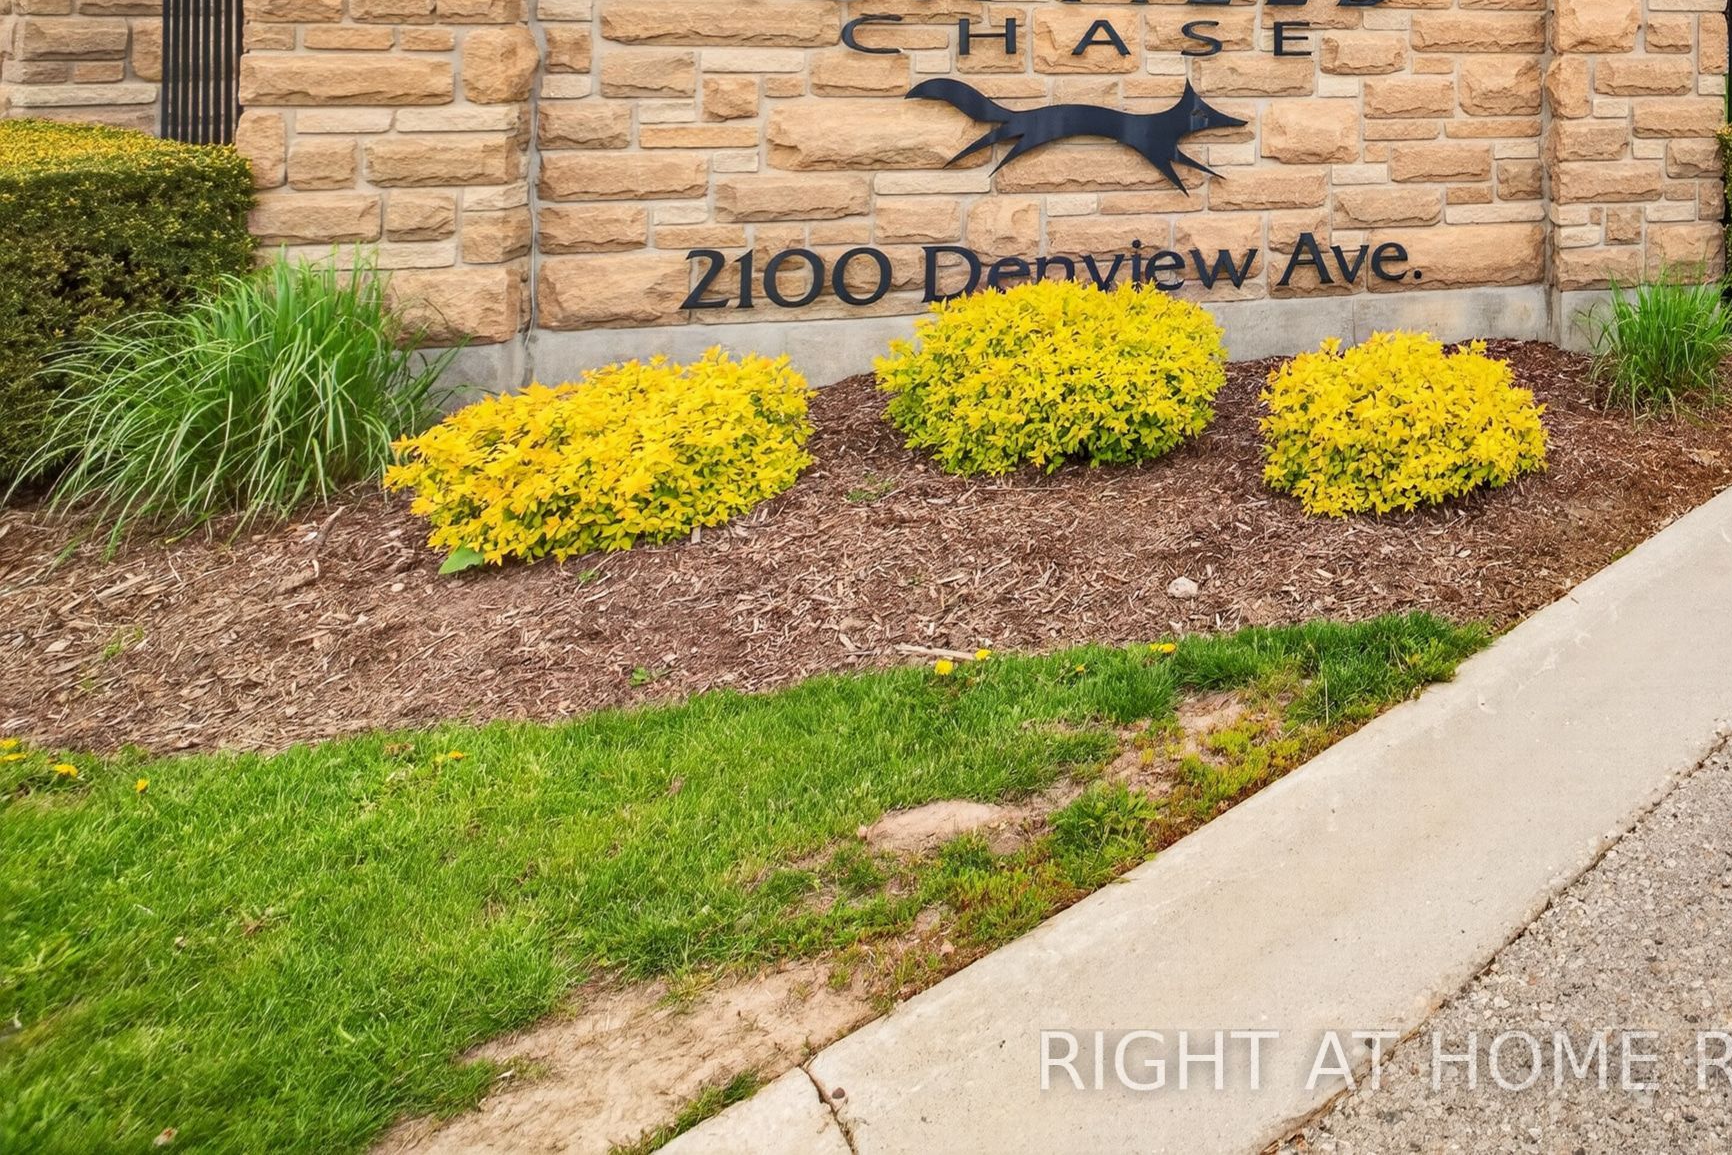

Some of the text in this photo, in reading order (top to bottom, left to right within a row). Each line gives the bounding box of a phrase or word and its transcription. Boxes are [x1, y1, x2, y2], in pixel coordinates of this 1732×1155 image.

[840, 13, 1314, 57] CHASE
[680, 232, 1422, 311] 2100 Denview Ave.
